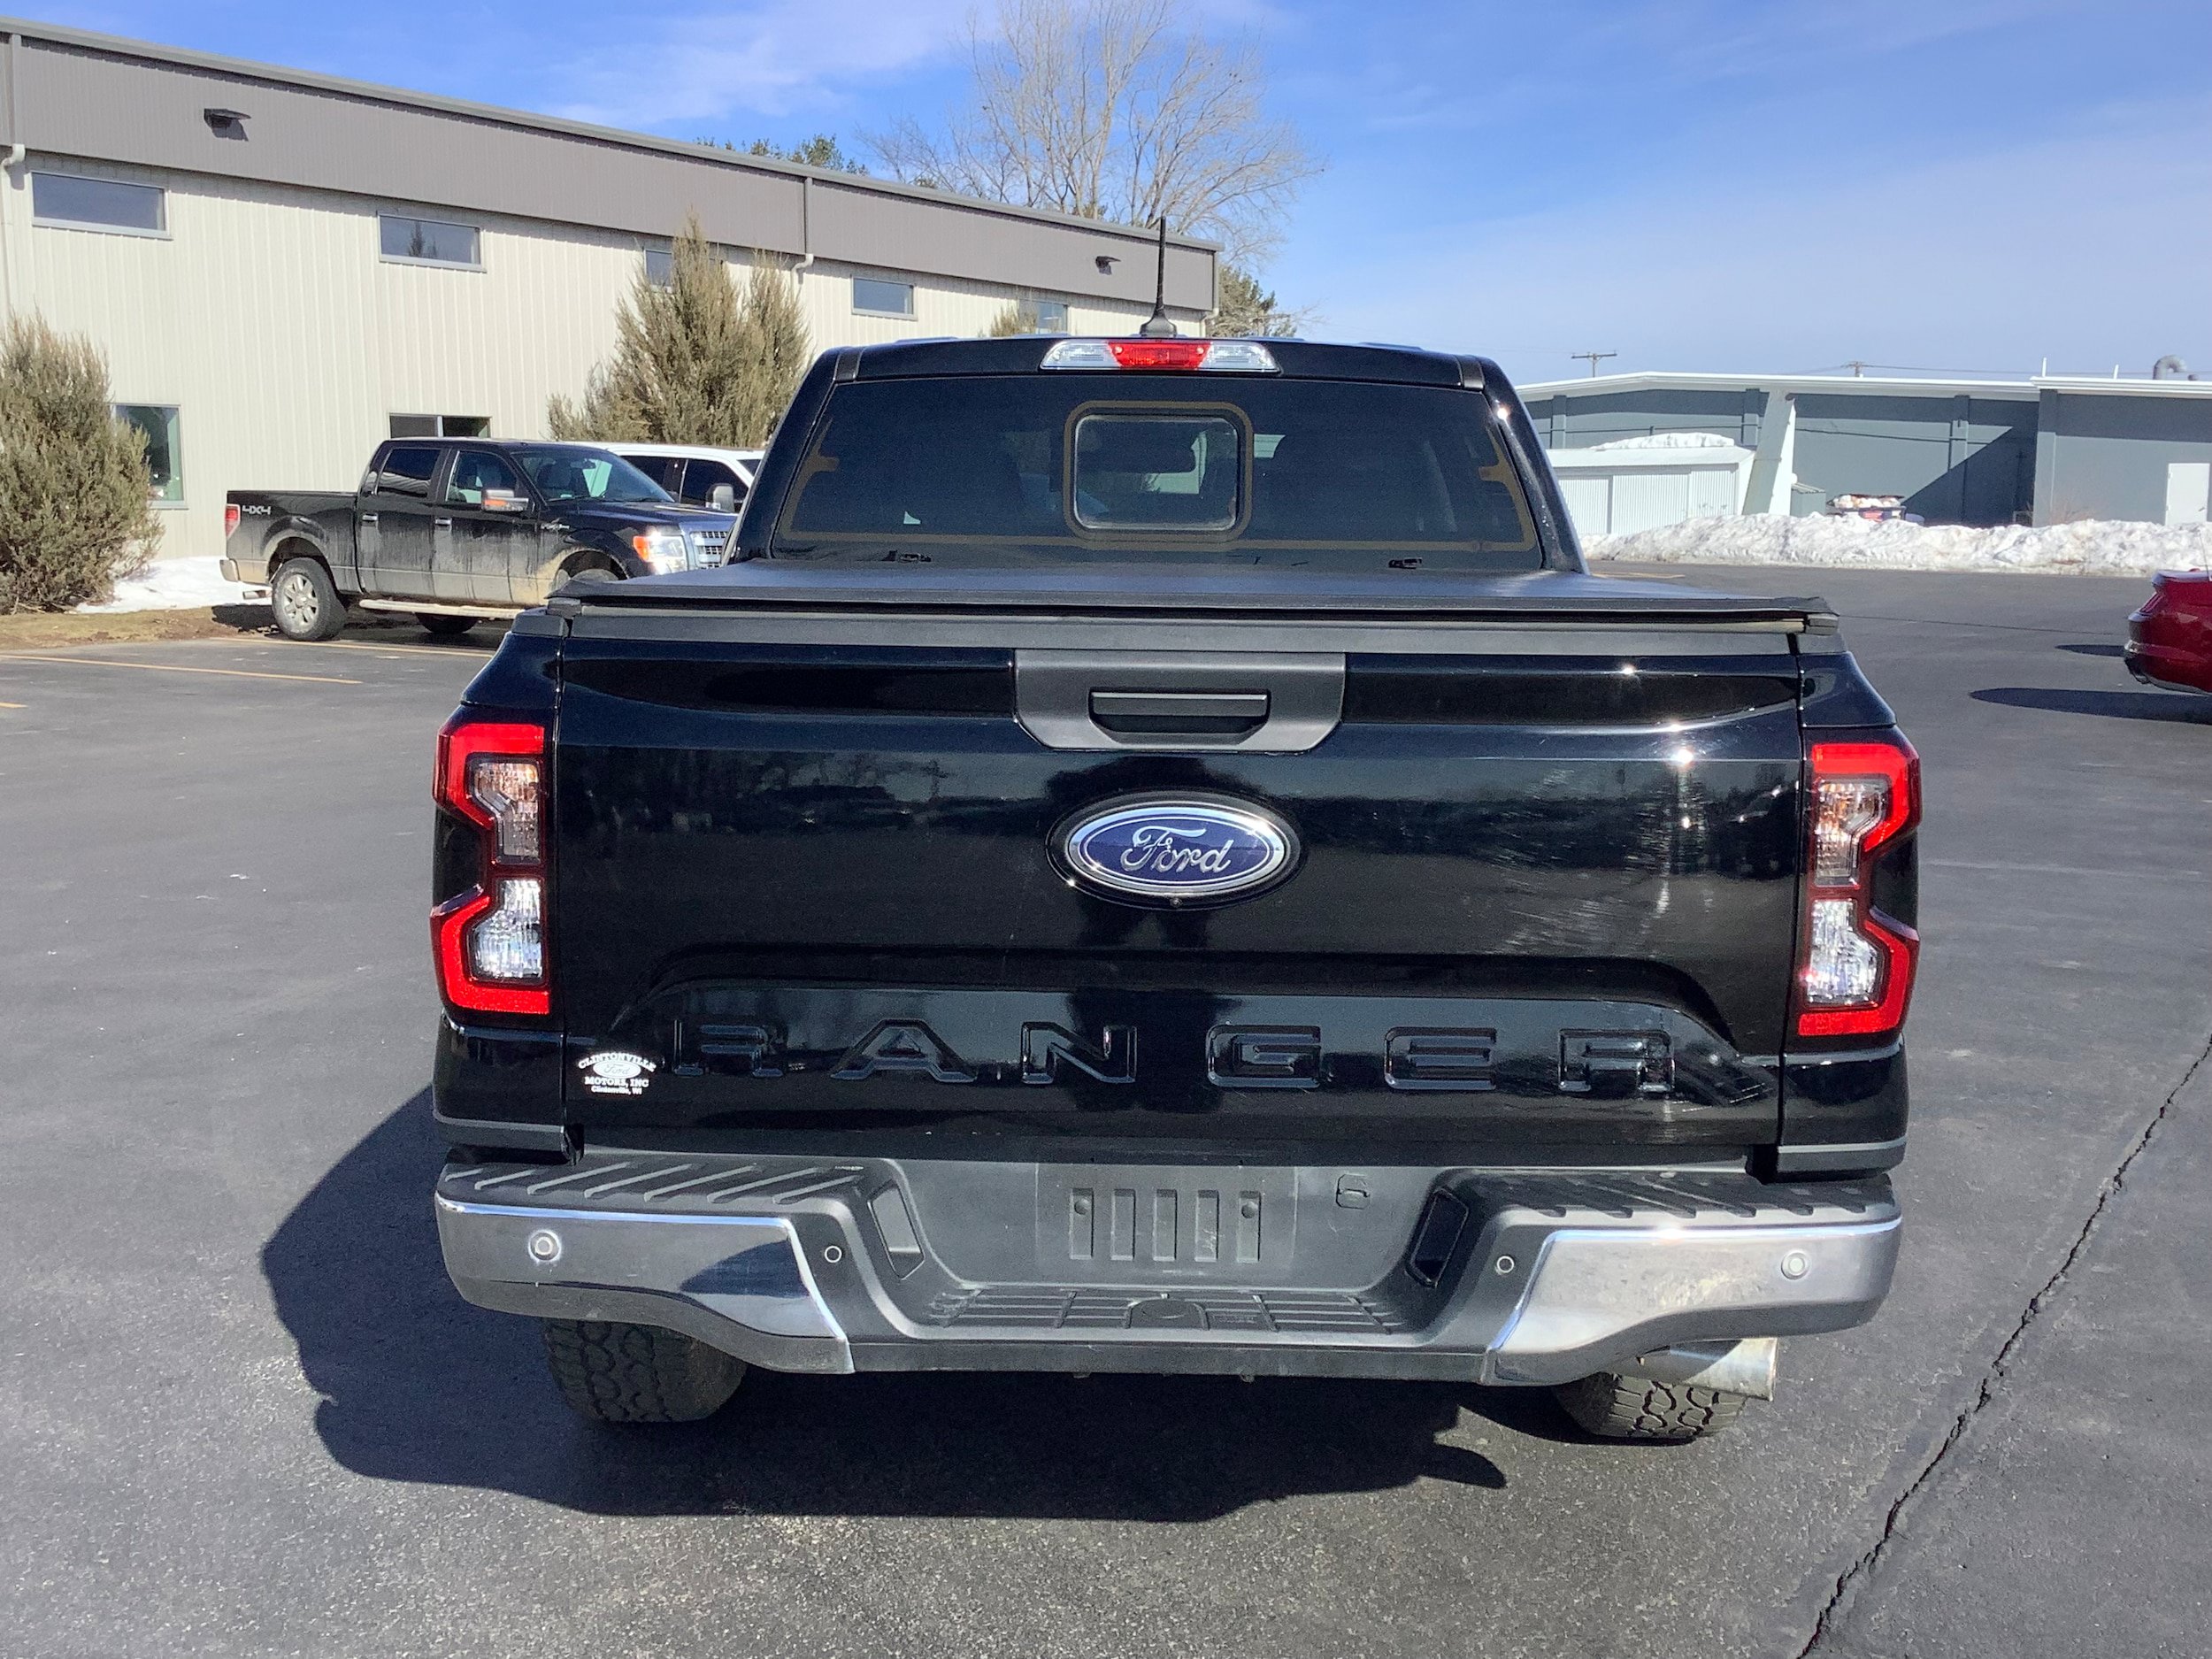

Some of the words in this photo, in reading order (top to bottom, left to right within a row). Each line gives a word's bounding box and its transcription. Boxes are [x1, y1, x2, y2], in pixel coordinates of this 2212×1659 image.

[1120, 826, 1234, 873] Ford
[578, 1052, 657, 1072] CLINTONVILLE
[673, 1018, 1674, 1093] RANGER
[603, 1063, 631, 1075] Ford
[630, 1079, 649, 1087] INC
